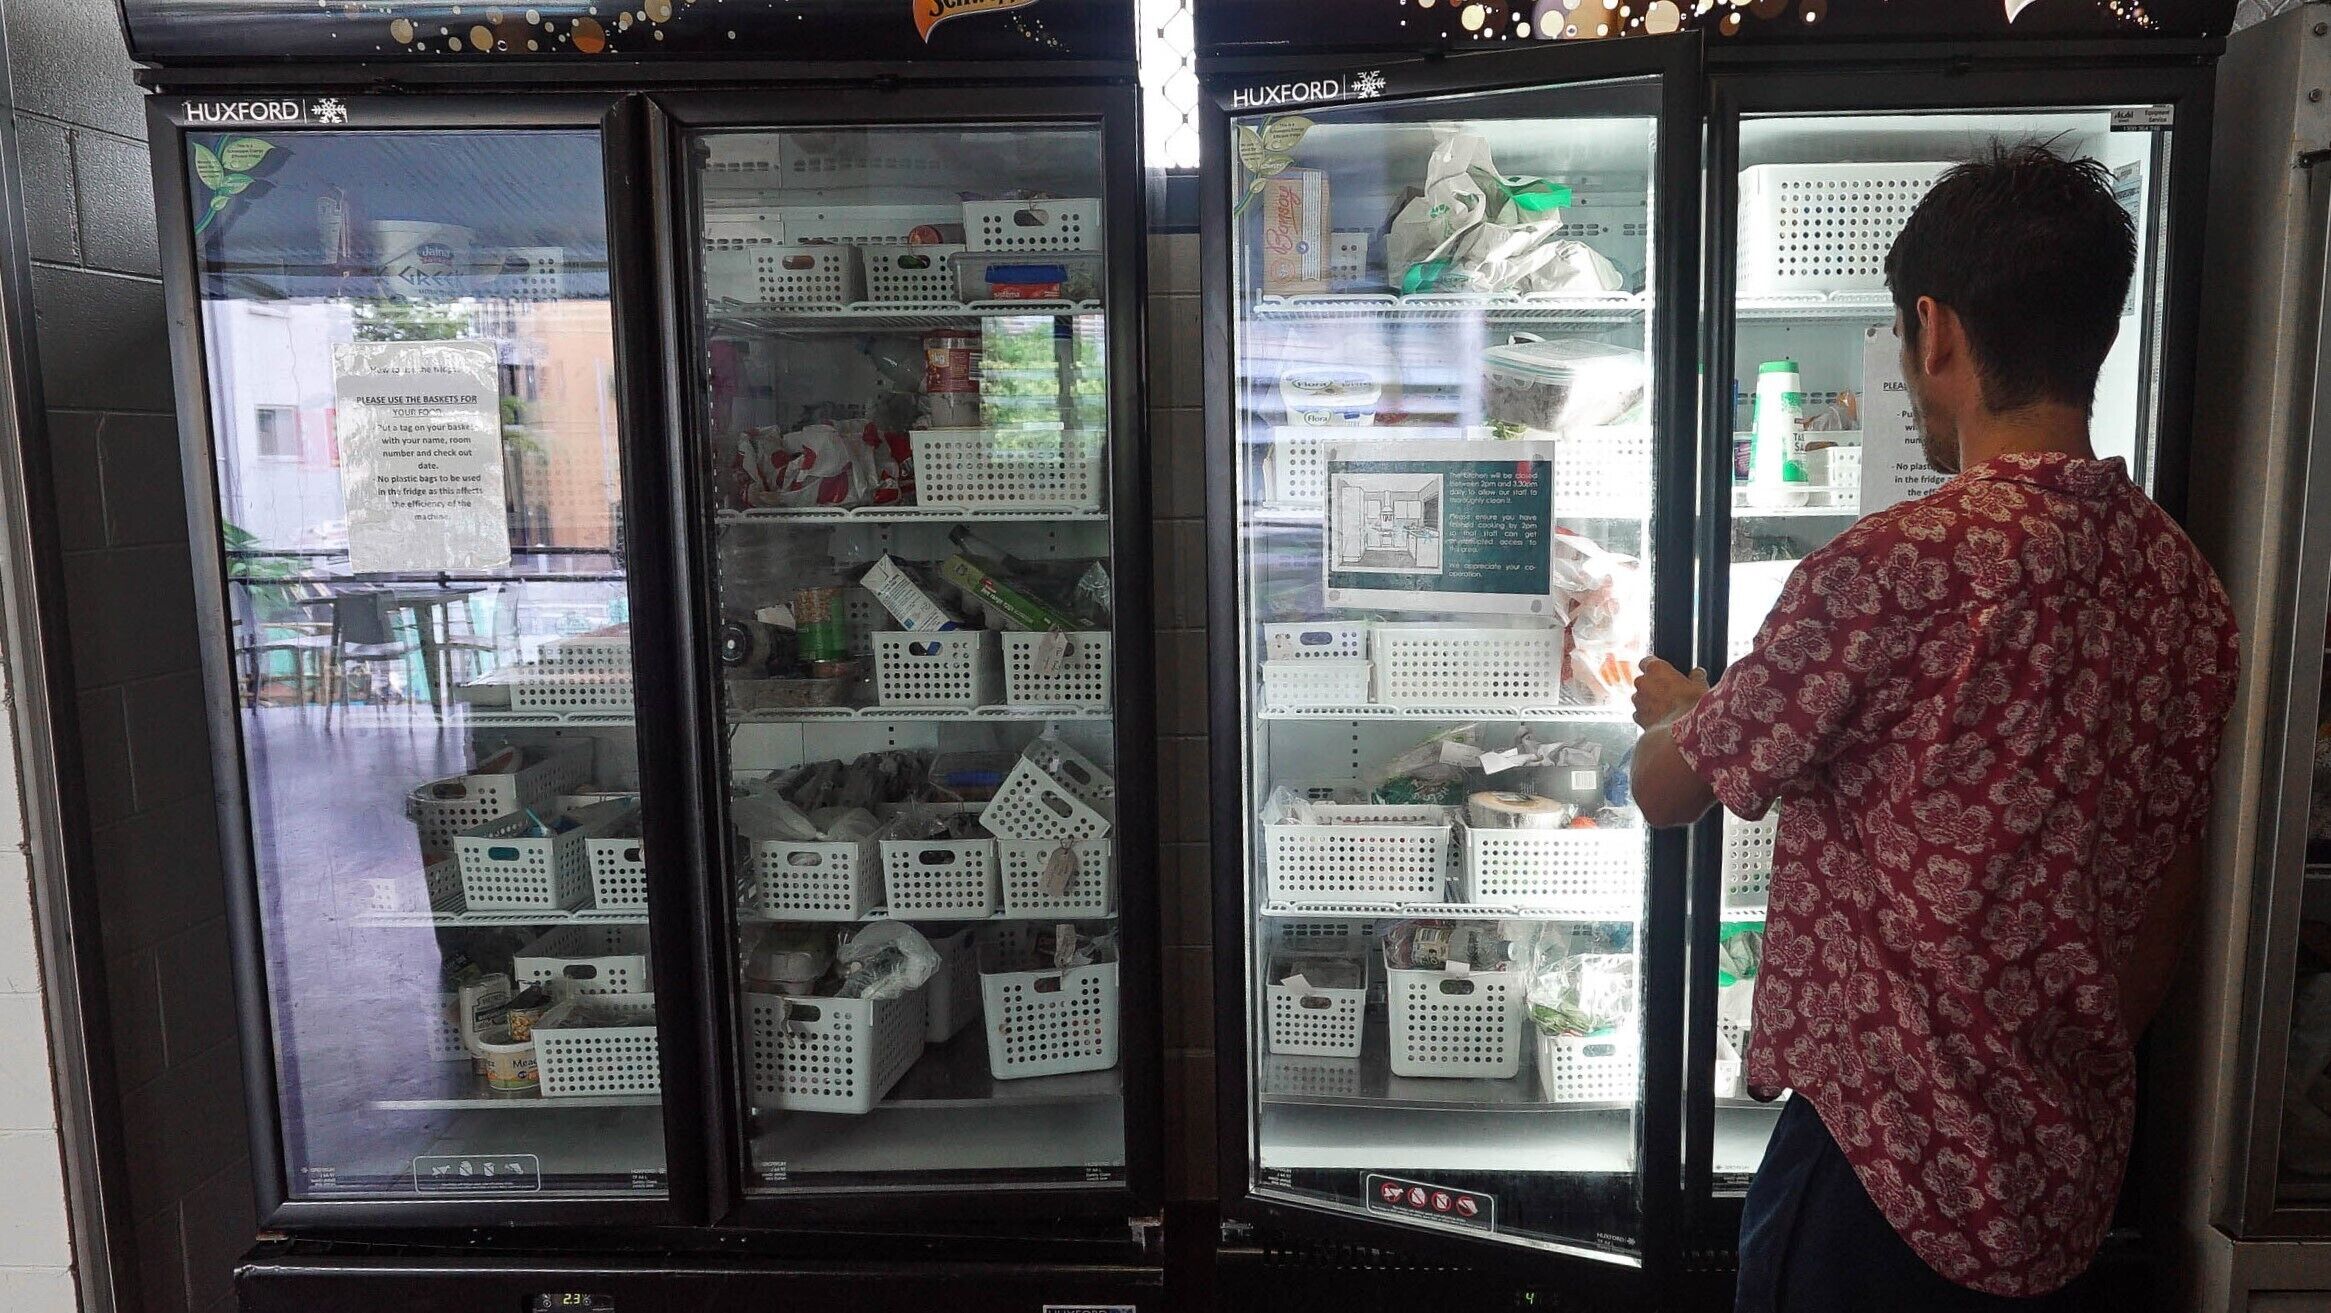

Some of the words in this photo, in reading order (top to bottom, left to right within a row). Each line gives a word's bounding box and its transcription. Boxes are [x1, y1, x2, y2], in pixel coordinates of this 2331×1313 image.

[1233, 80, 1338, 107] HUXFORD
[187, 101, 299, 122] HUXFORD
[356, 396, 386, 404] PLEASE
[388, 396, 403, 404] USE
[406, 396, 421, 404] THE
[423, 395, 459, 404] BASKETS
[461, 395, 477, 404] FOR
[392, 408, 417, 416] YOUR
[400, 425, 413, 434] tag
[382, 436, 400, 444] with
[402, 437, 421, 445] your
[422, 437, 447, 445] name,
[383, 449, 414, 457] number
[416, 449, 432, 457] and
[434, 449, 457, 457] check
[418, 462, 439, 470] date.
[391, 475, 418, 484] plastic
[419, 475, 438, 483] bags
[1921, 476, 1945, 485] fridge
[403, 488, 427, 496] fridge
[440, 487, 455, 495] this
[563, 1293, 581, 1305] 2.3
[1525, 1292, 1535, 1305] 4
